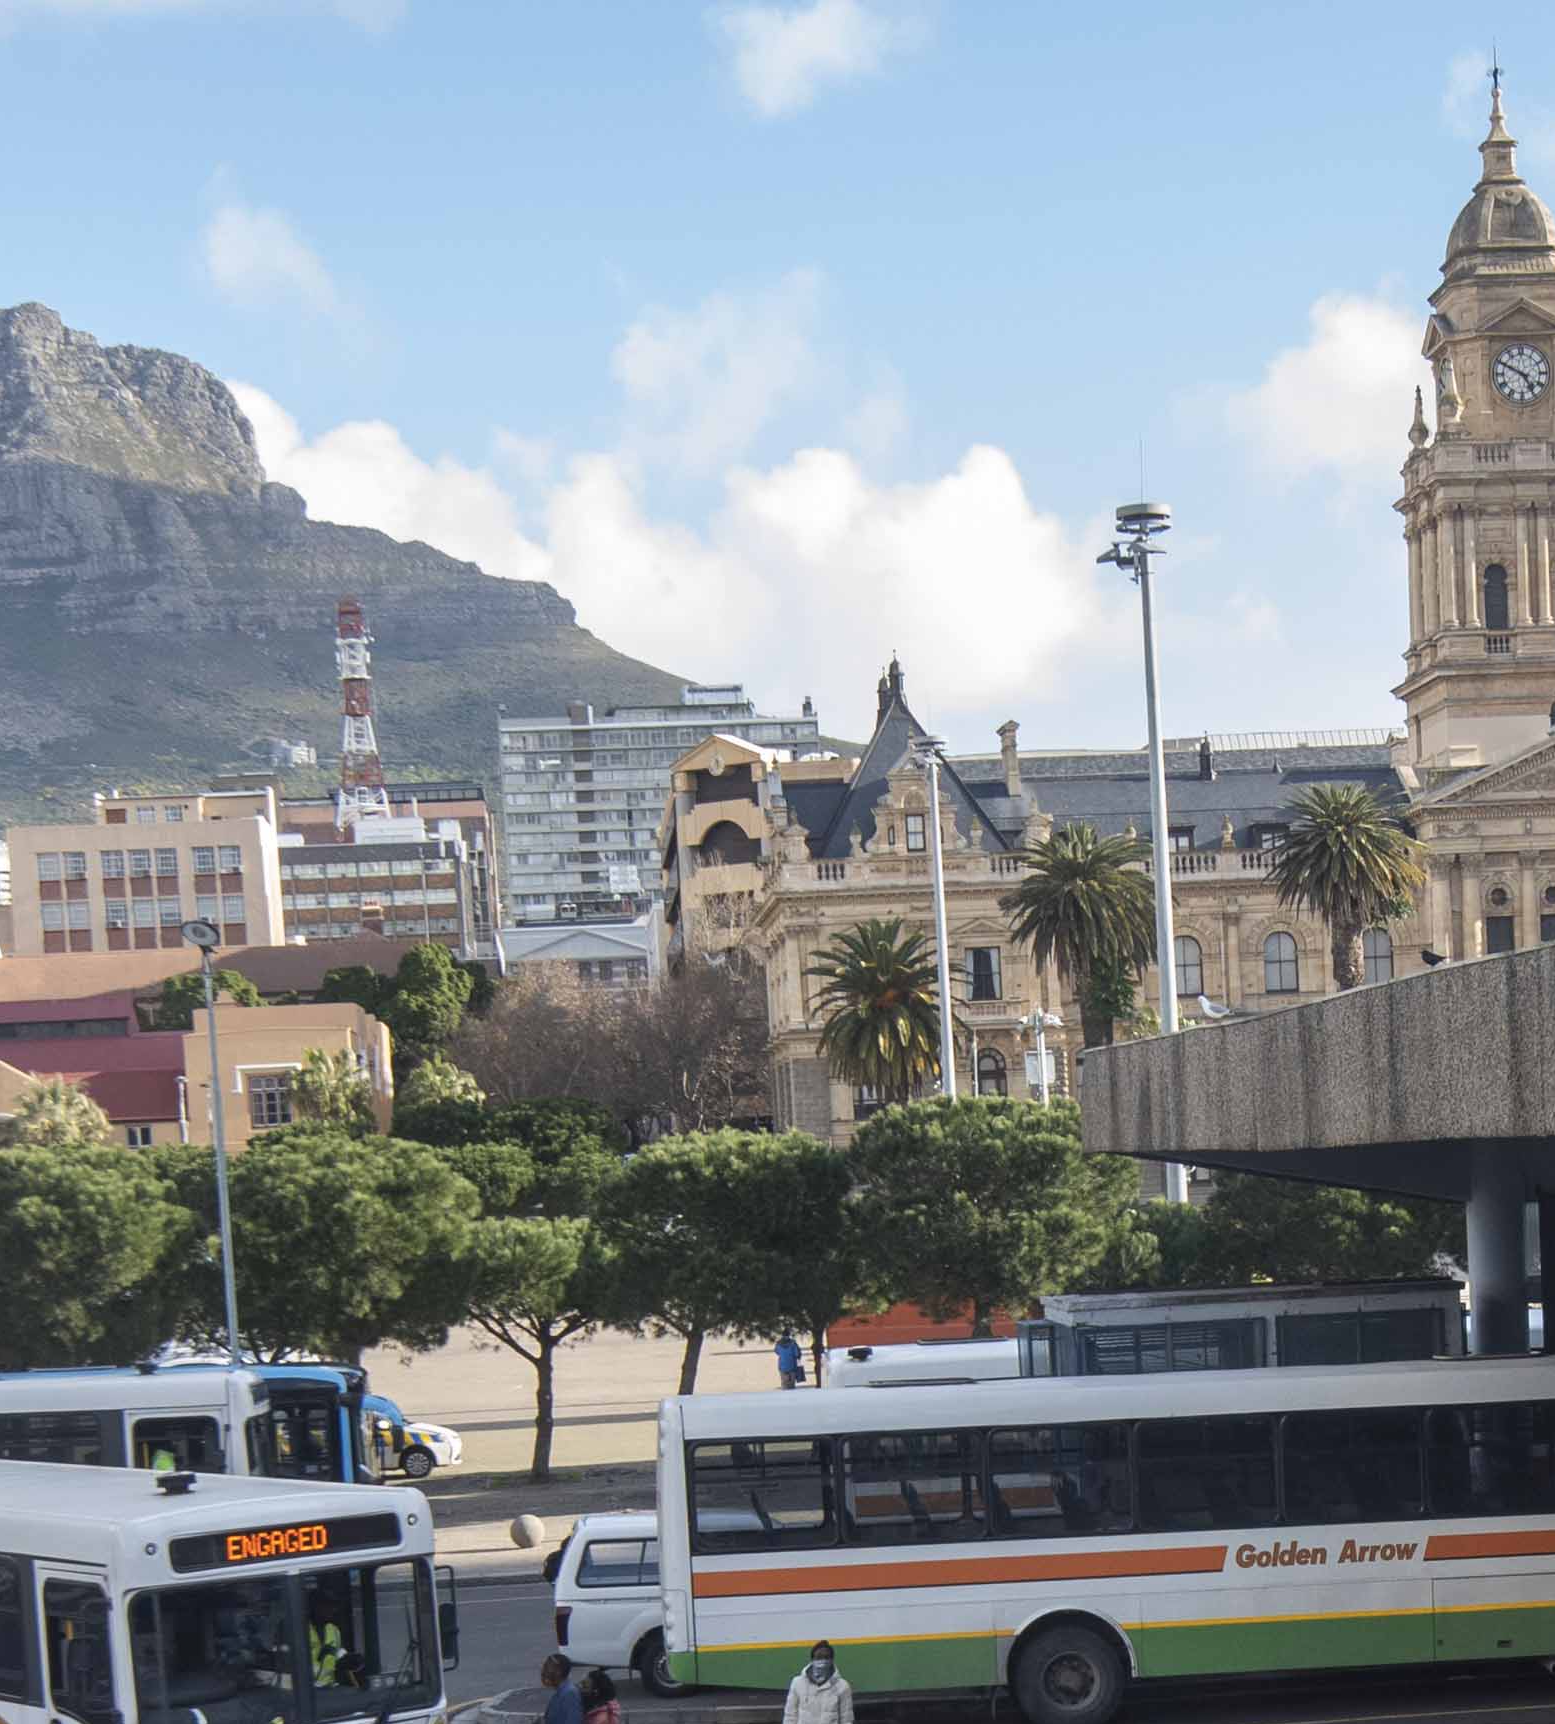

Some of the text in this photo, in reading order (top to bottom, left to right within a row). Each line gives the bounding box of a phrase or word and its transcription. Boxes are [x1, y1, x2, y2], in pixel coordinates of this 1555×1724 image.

[225, 1525, 328, 1562] ENGAGED
[1235, 1538, 1420, 1568] Golden Arrow
